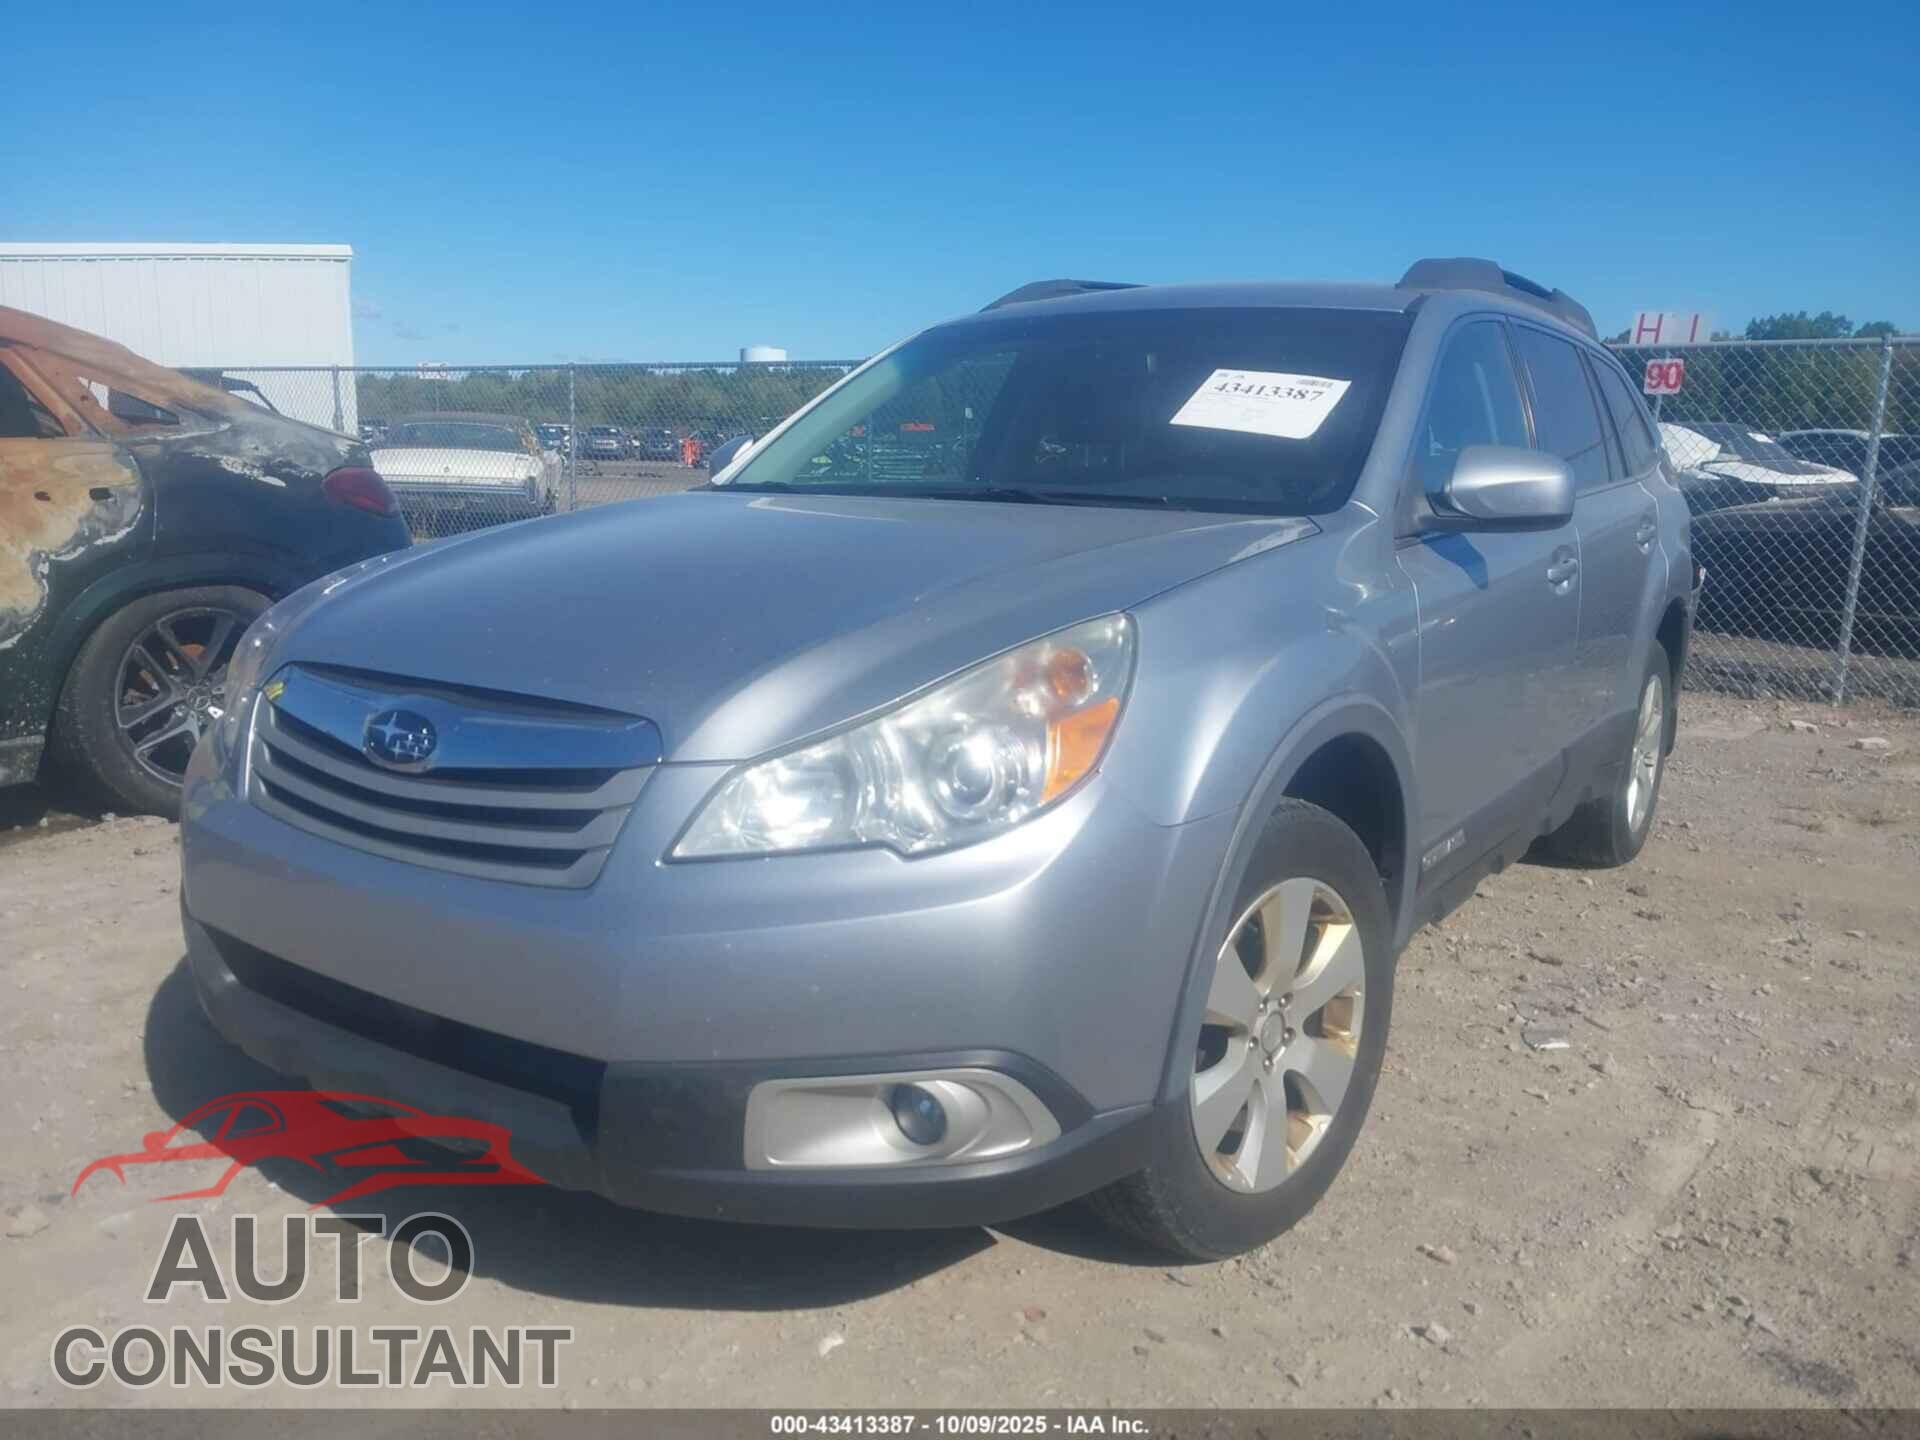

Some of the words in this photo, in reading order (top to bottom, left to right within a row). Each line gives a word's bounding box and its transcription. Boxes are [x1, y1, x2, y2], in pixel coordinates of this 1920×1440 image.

[1636, 313, 1663, 344] H
[1647, 362, 1682, 390] 90
[1214, 381, 1325, 402] 43413387
